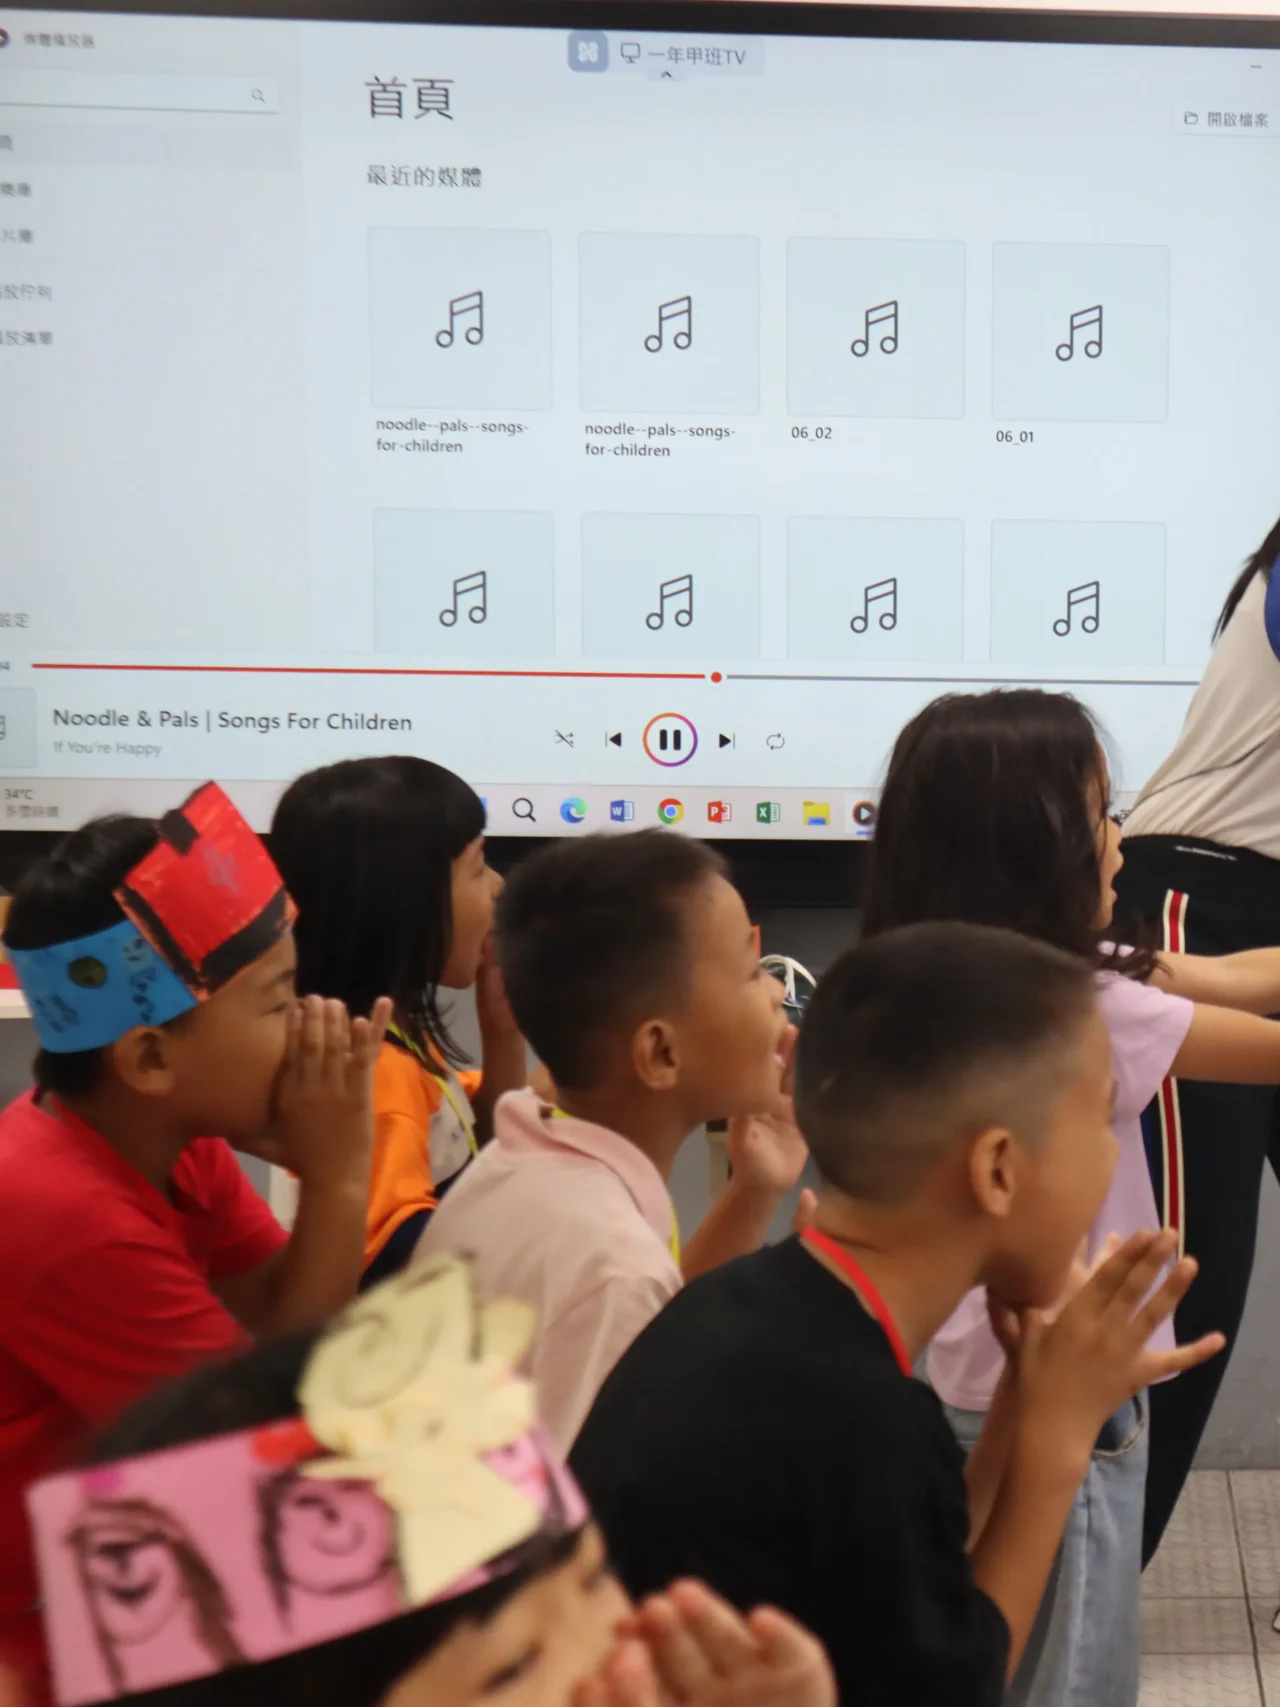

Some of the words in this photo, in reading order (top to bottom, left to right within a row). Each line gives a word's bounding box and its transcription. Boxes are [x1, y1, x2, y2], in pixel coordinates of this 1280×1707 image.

[648, 45, 746, 66] 一年甲班TV
[365, 75, 455, 121] 首頁
[1207, 110, 1269, 129] 開啟檔案
[366, 163, 482, 188] 最近的媒體
[791, 426, 833, 441] 06_02
[996, 430, 1034, 445] 06_01
[376, 438, 463, 453] for-children
[585, 443, 671, 458] for-children
[53, 709, 130, 727] Noodle
[137, 710, 152, 727] &
[160, 711, 199, 728] Pals
[218, 711, 281, 734] Songs
[288, 712, 320, 729] For
[327, 713, 412, 731] Children
[53, 741, 64, 753] If
[67, 742, 112, 755] You're
[117, 743, 162, 758] Happy
